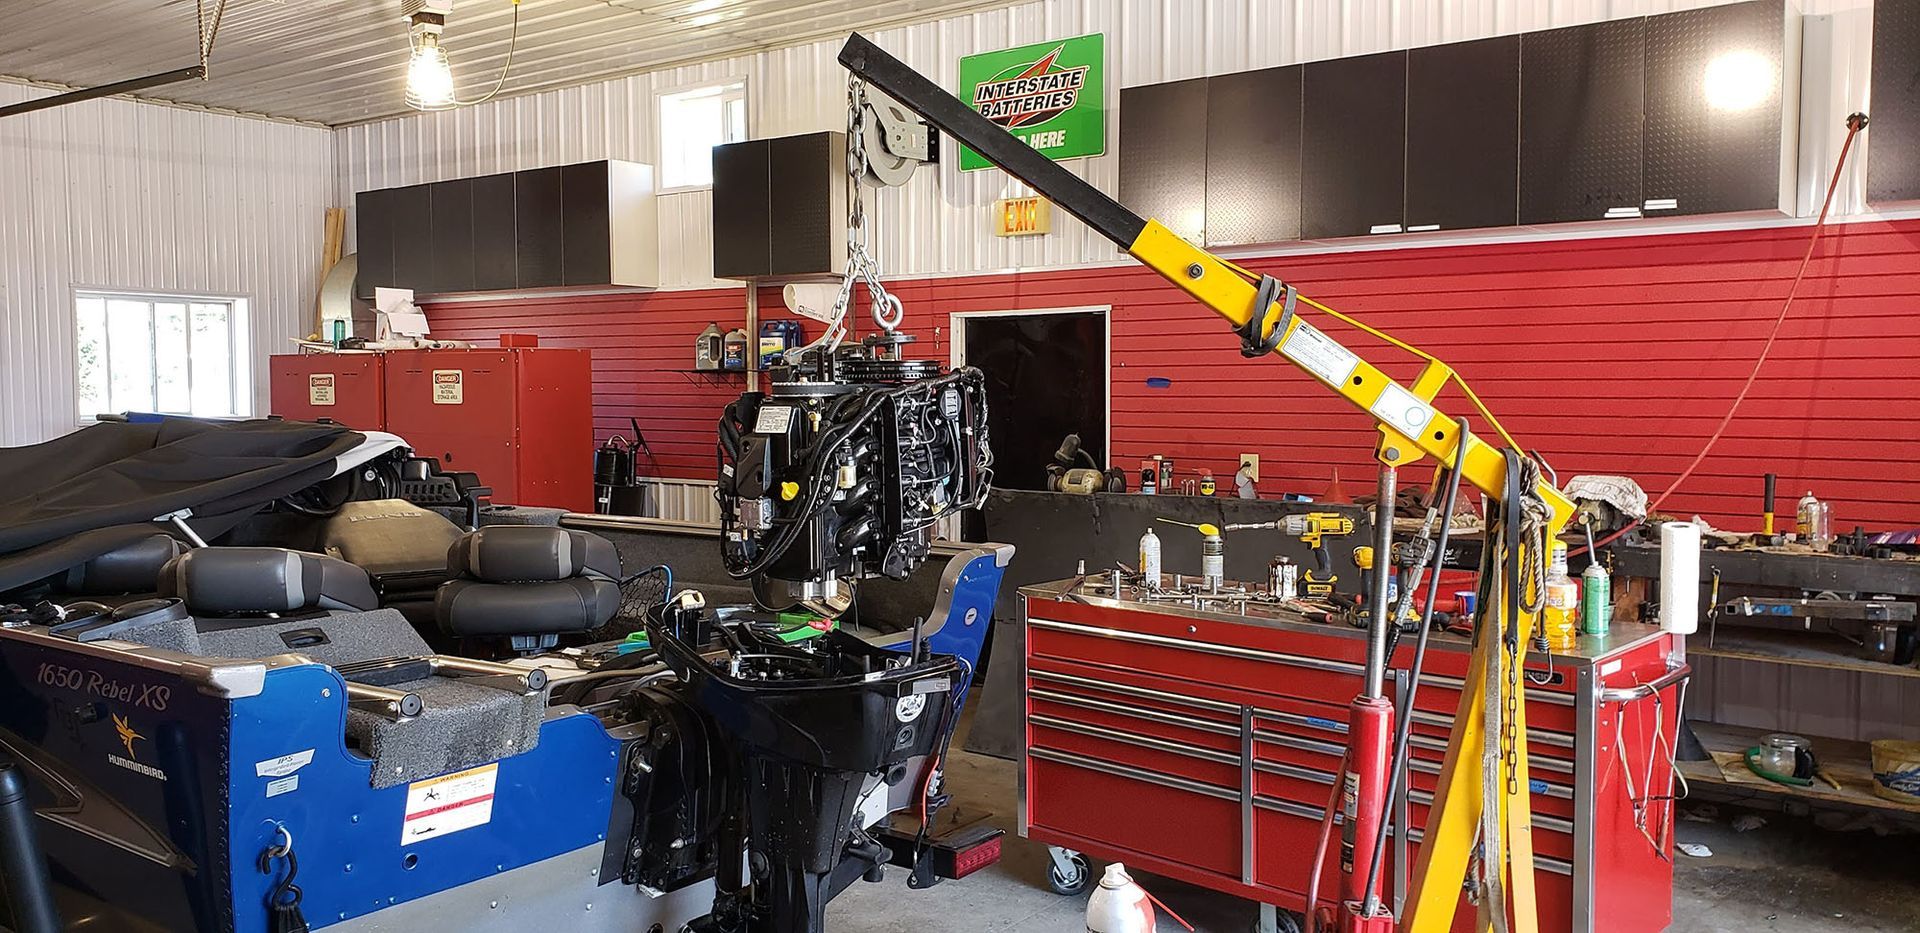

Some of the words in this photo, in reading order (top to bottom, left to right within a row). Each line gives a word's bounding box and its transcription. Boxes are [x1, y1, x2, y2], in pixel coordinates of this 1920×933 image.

[976, 70, 1082, 101] INTERSTATE
[980, 91, 1075, 118] BATTERIES
[1029, 129, 1067, 150] HERE
[1005, 199, 1038, 232] EXIT
[37, 662, 83, 690] 1650
[87, 670, 135, 703] Rebel
[135, 683, 171, 712] XS
[108, 753, 164, 780] HUMMINBIRD
[440, 771, 470, 782] WARNING
[437, 802, 464, 813] DANGER
